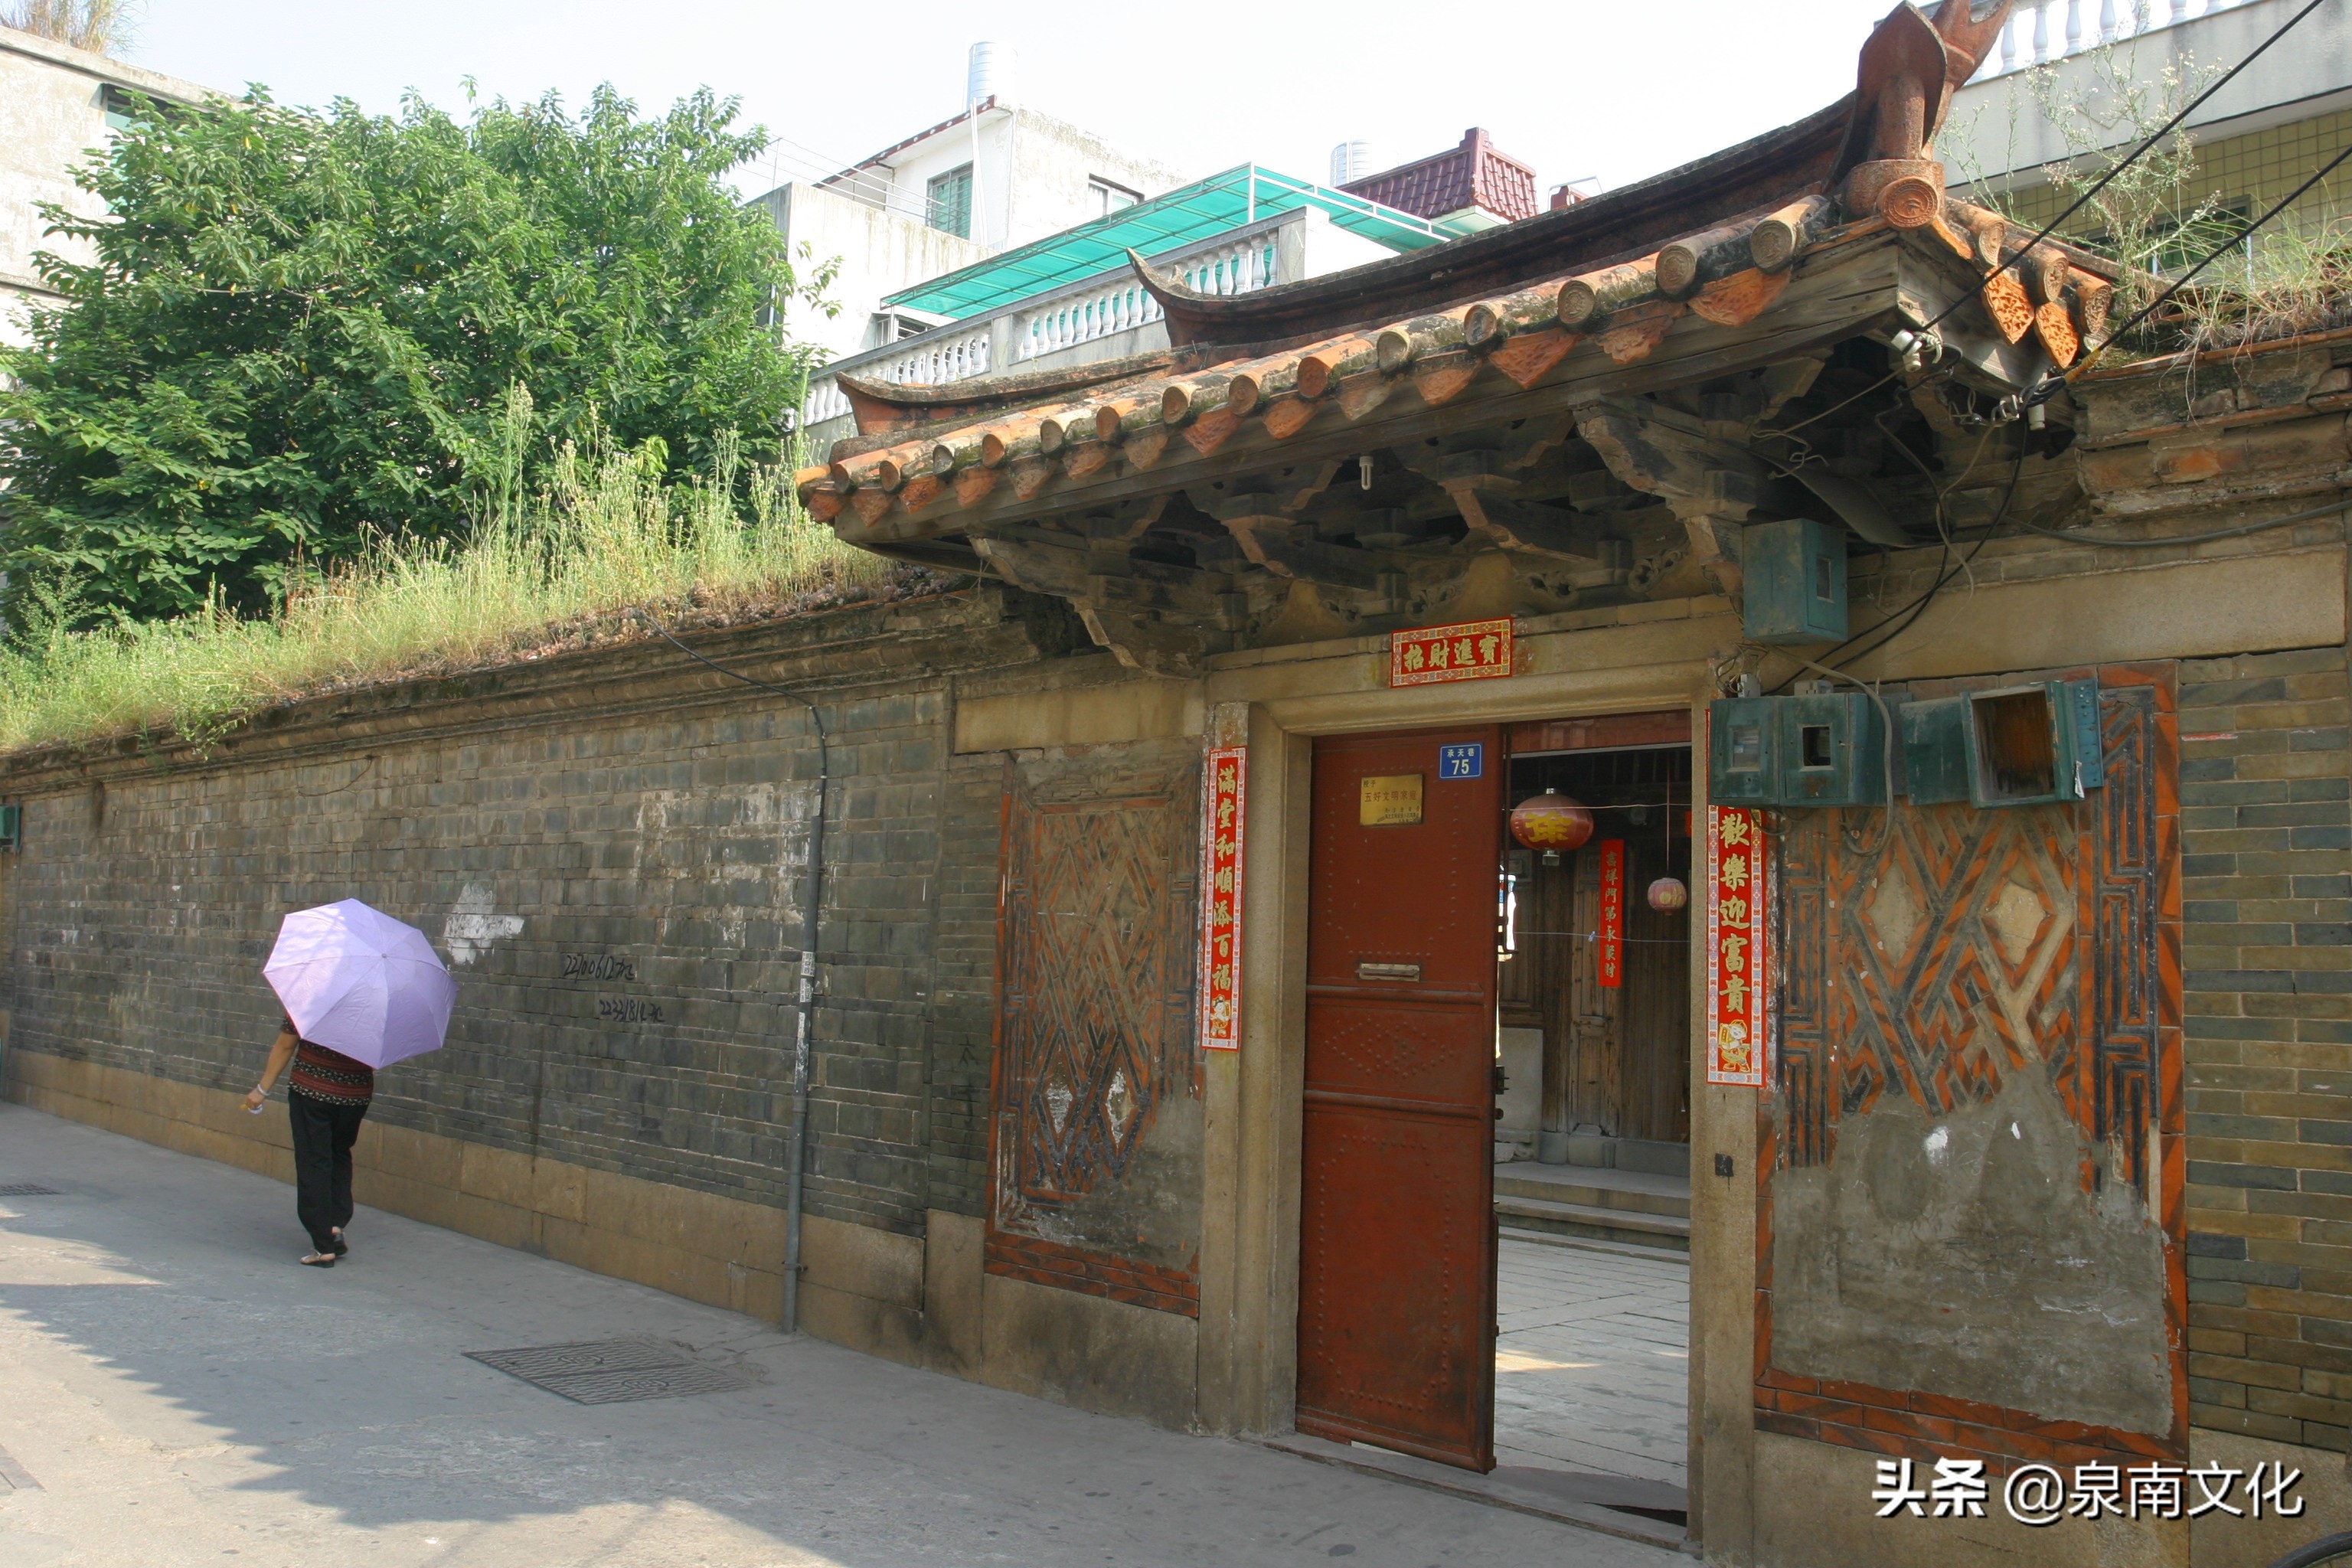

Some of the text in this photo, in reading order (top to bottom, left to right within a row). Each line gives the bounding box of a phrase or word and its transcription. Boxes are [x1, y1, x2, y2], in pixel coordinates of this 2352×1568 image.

[1446, 747, 1475, 758] 承天巷
[1451, 759, 1470, 775] 75
[1719, 807, 1751, 1014] 歡樂迎富貴
